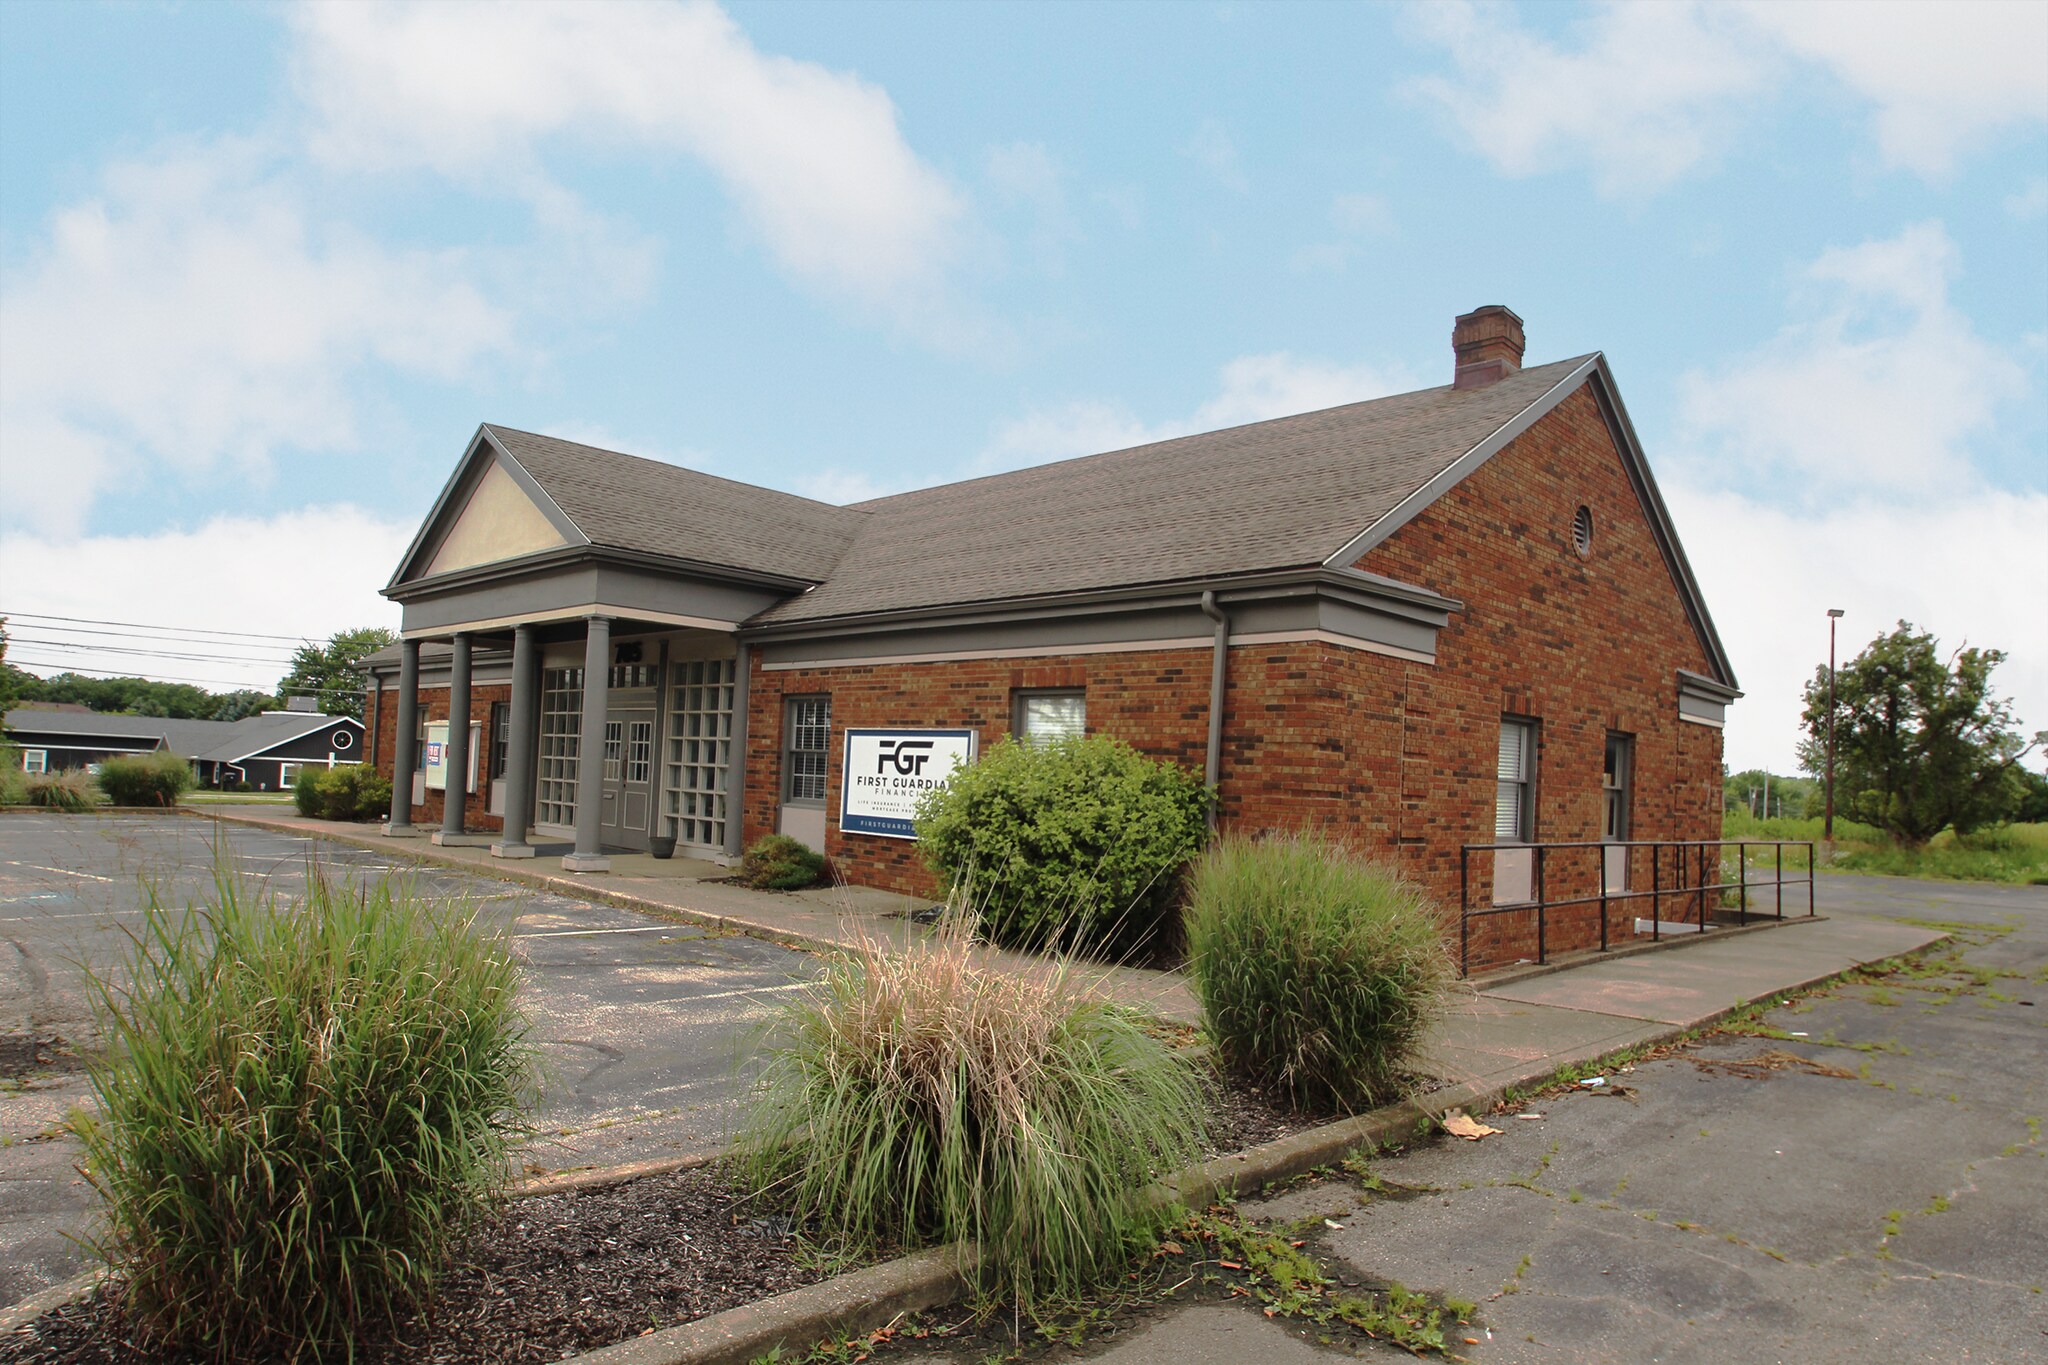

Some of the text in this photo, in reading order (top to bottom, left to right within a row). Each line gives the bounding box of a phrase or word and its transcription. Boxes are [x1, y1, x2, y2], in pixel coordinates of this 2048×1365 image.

[878, 741, 934, 775] FGF
[857, 776, 949, 789] FIRST GUARDIA
[874, 788, 919, 797] FINANCI
[860, 820, 915, 831] FIRSTGUARDIA
